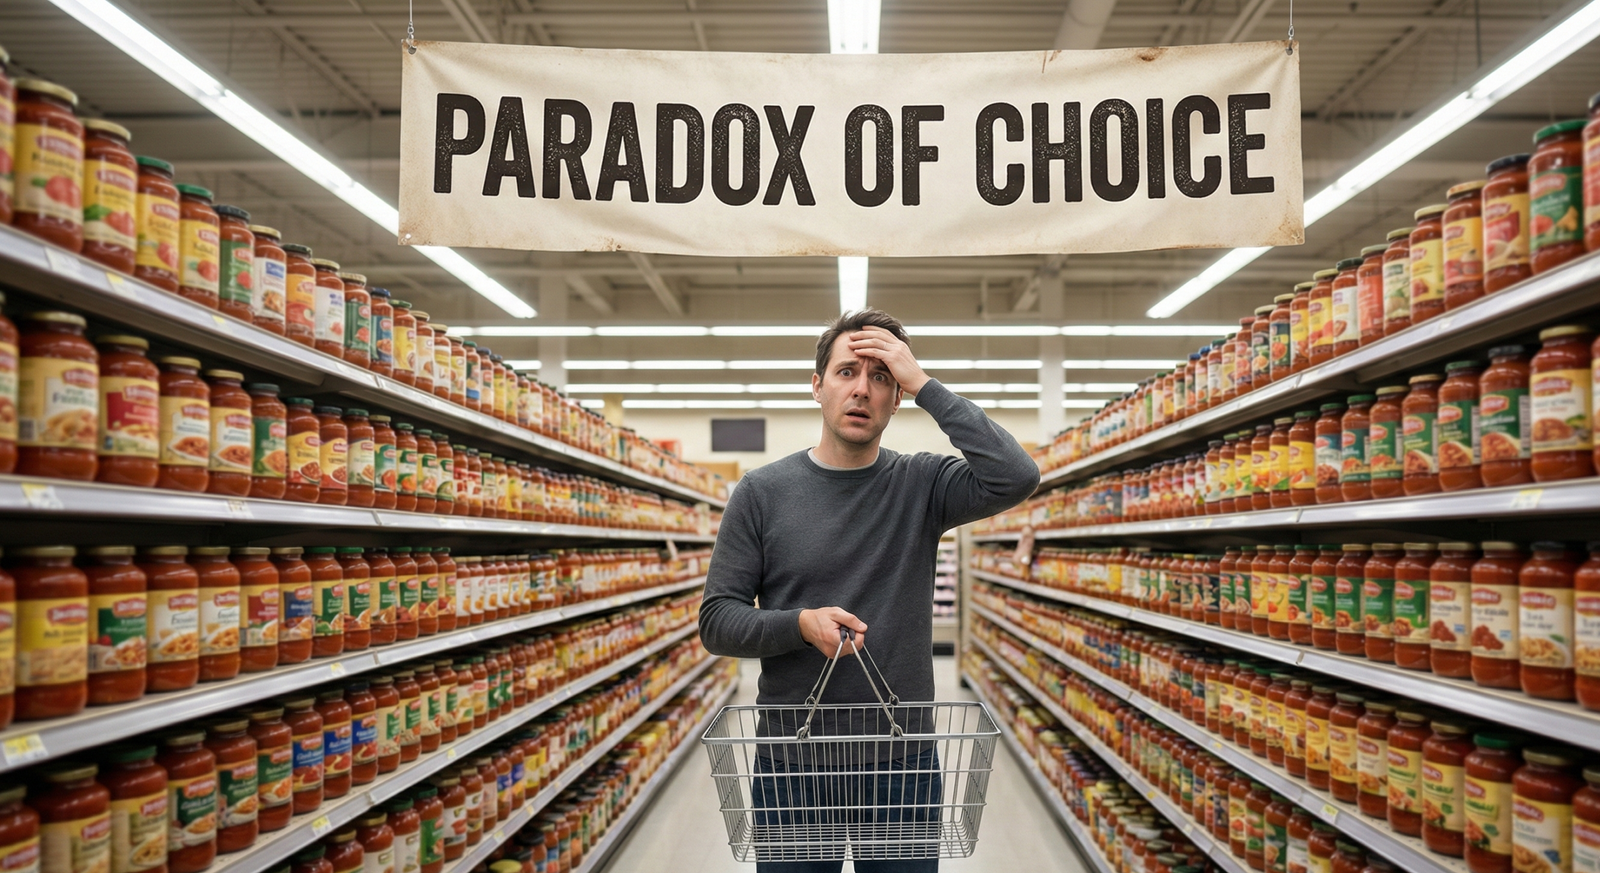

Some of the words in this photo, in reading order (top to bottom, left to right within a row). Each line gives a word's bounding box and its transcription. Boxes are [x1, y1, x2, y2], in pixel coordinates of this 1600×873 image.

[434, 93, 815, 206] PARADOX
[845, 105, 944, 207] OF
[976, 93, 1274, 206] CHOICE
